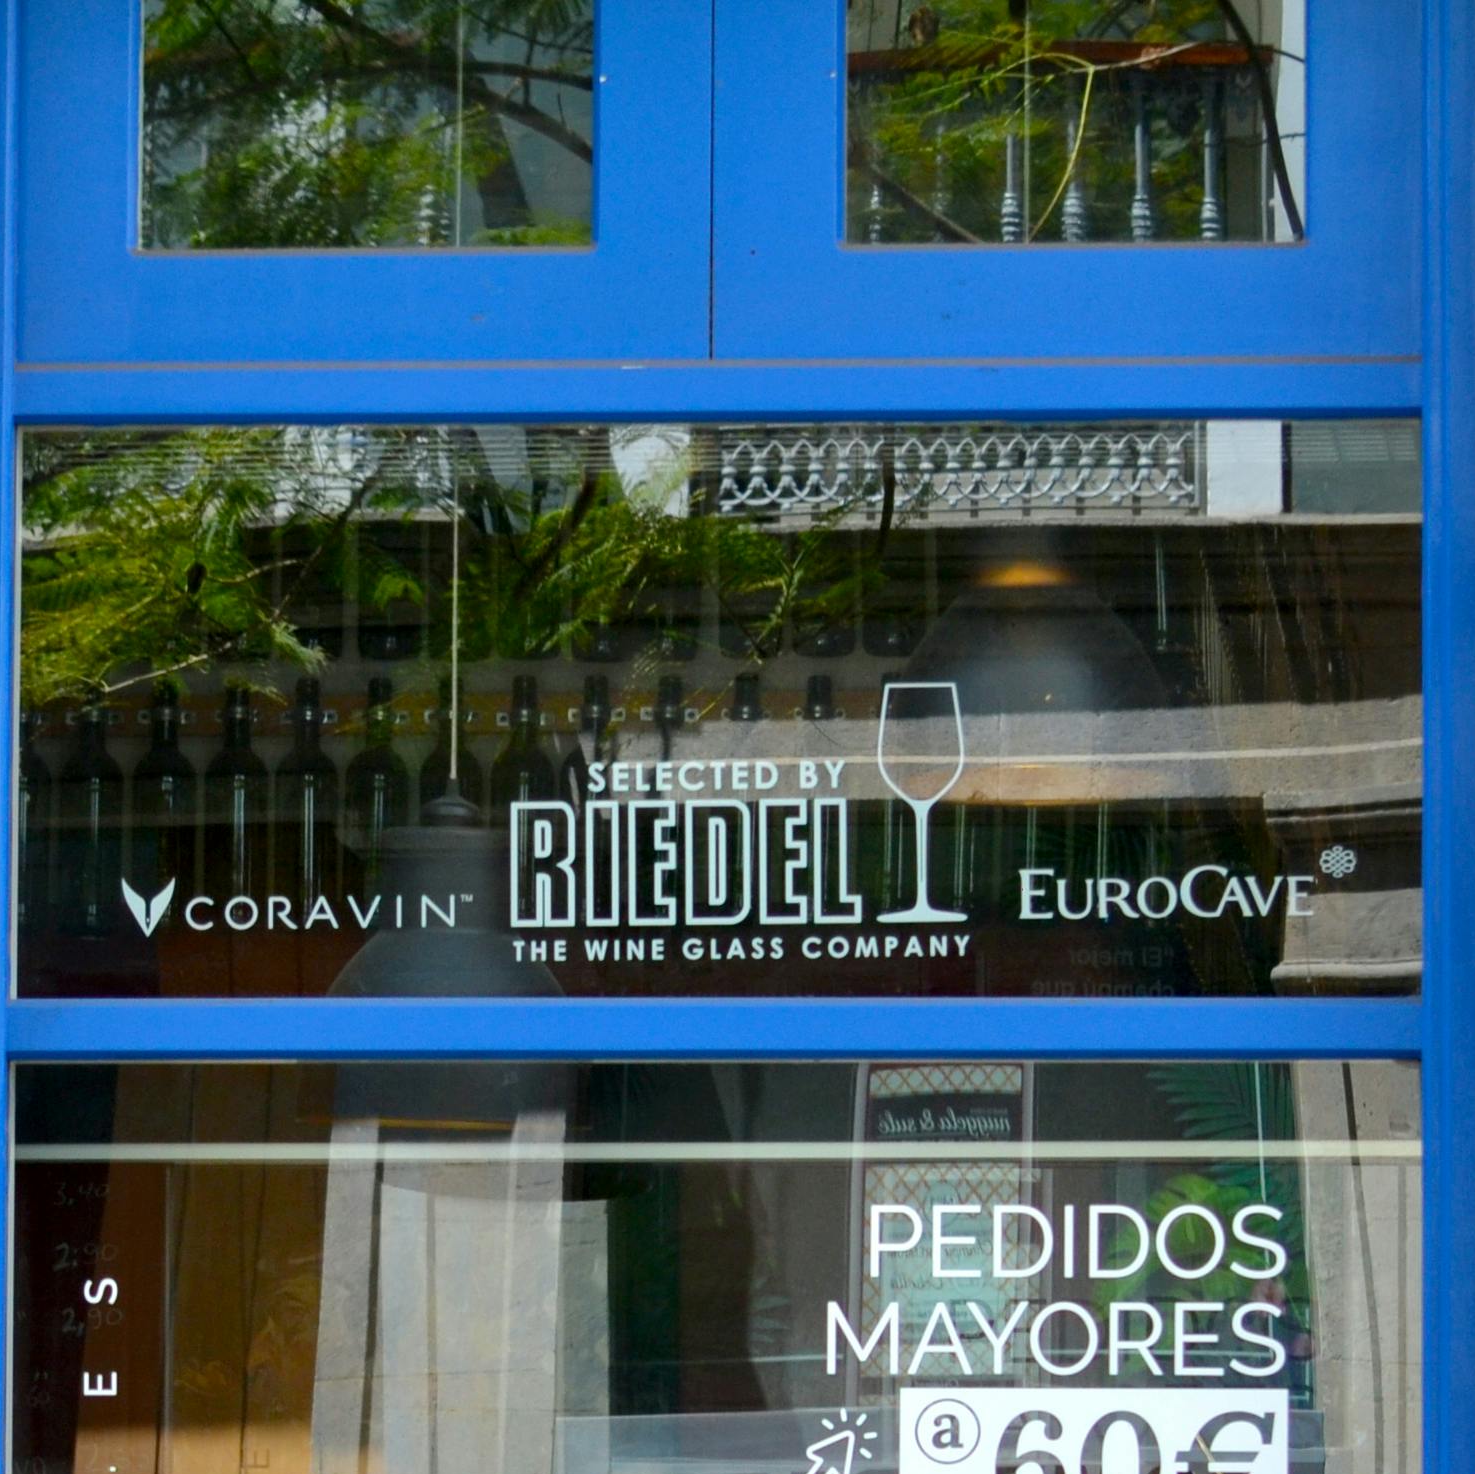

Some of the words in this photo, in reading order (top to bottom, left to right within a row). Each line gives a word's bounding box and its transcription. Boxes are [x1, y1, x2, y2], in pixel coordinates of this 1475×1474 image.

[587, 760, 779, 792] SELECTED
[799, 759, 846, 789] BY
[510, 798, 862, 927] RIEDEL
[513, 940, 568, 962] THE
[584, 938, 666, 960] WINE
[682, 937, 785, 960] GLASS
[801, 935, 971, 958] COMPANY
[869, 1204, 1287, 1279] PEDIDOS
[826, 1301, 1287, 1376] MAYORES
